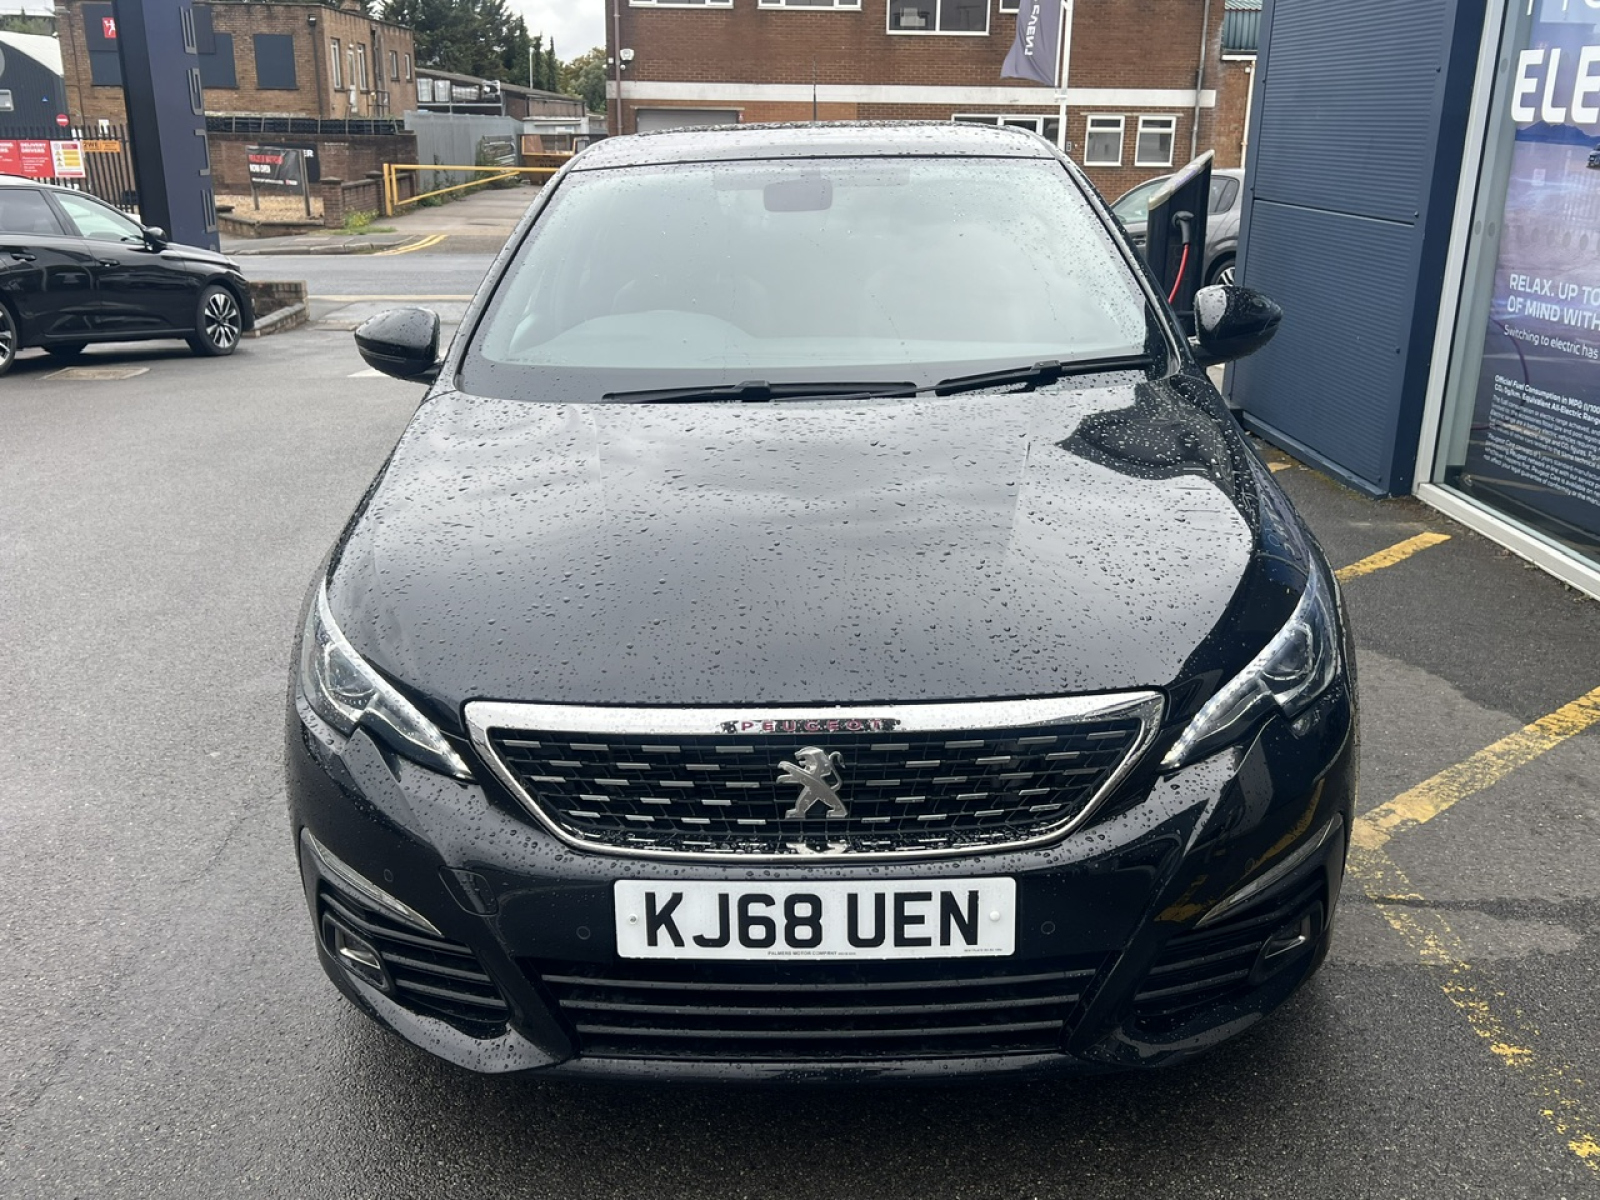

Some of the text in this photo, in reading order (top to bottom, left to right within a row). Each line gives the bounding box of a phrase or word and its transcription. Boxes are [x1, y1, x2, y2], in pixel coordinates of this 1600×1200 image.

[1511, 46, 1600, 123] ELE
[1509, 273, 1554, 297] RELAX.
[1558, 282, 1578, 301] UP
[1507, 295, 1524, 313] OF
[1525, 299, 1560, 322] MIND
[1504, 324, 1599, 359] Switching to electric has
[741, 718, 881, 732] PEUGEOT
[644, 889, 980, 949] KJ68 UEN
